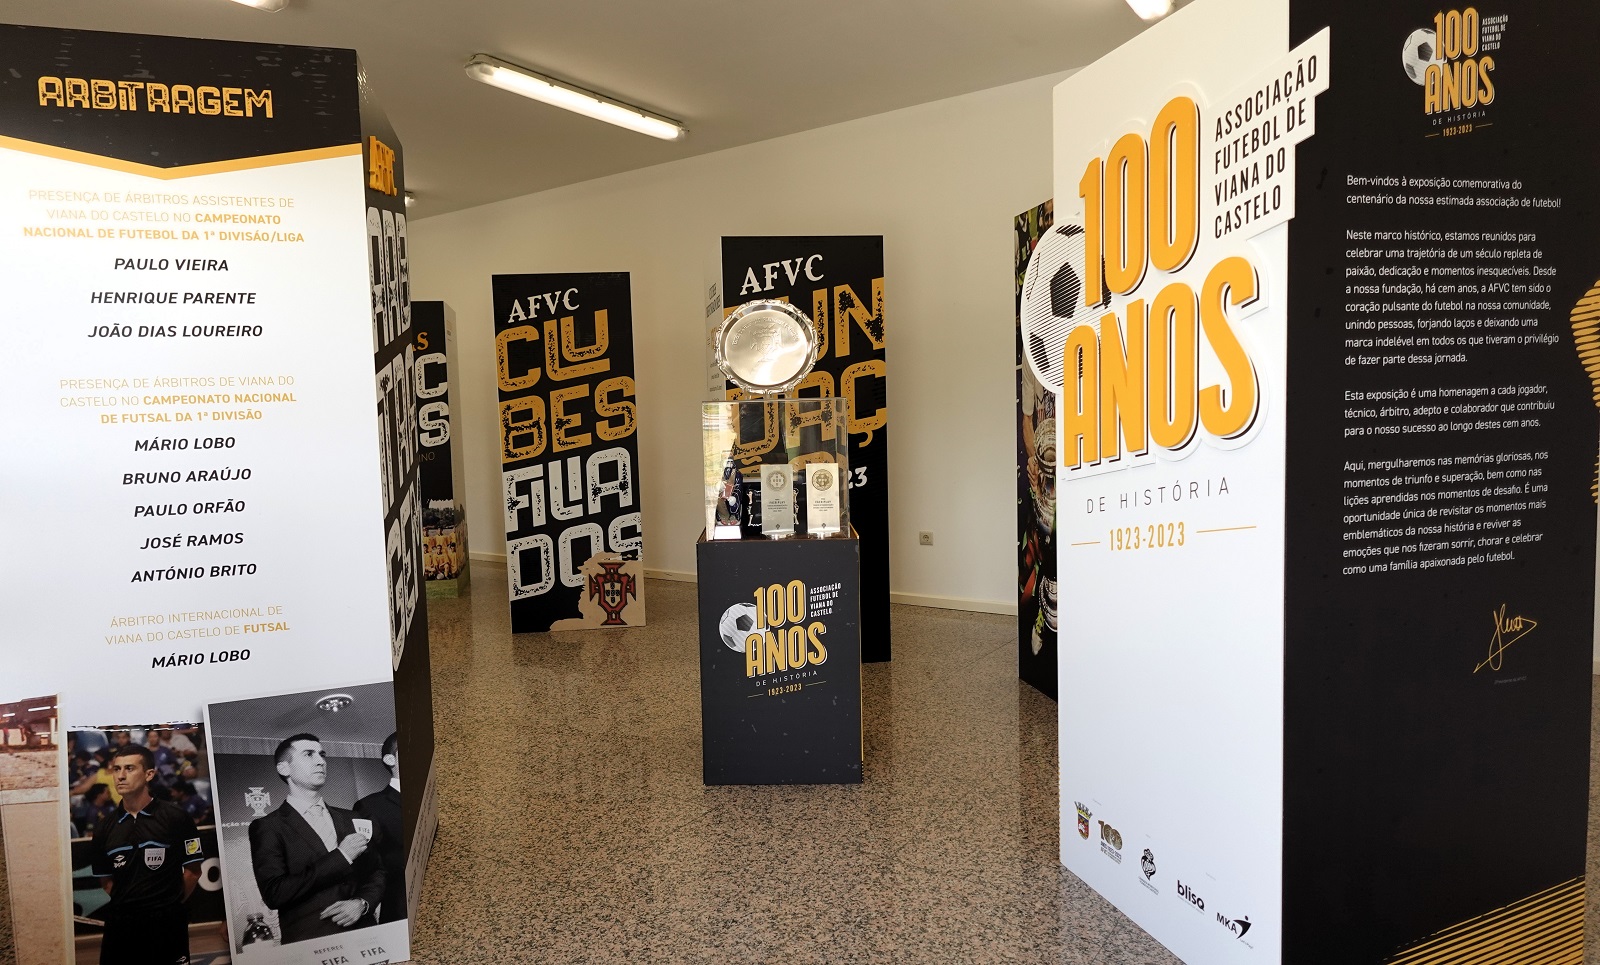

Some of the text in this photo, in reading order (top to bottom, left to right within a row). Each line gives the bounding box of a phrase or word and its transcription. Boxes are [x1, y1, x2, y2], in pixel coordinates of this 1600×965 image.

[1434, 8, 1479, 60] 100
[1482, 26, 1500, 34] FUTEBOL
[1482, 42, 1500, 51] CASTELO
[1425, 56, 1494, 114] ANOS
[38, 76, 274, 118] ARBITRAGEM
[1215, 55, 1317, 142] ASSOCIAÇÃO
[1448, 111, 1486, 122] HISTÓRIA
[1215, 97, 1306, 174] FUTEBOL DE
[1443, 124, 1472, 136] 1923-2023
[1215, 146, 1285, 206] VIANA DO
[1347, 175, 1522, 189] Bem-vindos à exposição comemorativa do
[29, 189, 294, 207] PRESENÇA DE ÁRBITROS ASSISTENTES DE
[1079, 96, 1201, 308] 100
[1347, 194, 1393, 204] centenário
[1396, 194, 1406, 204] da
[1436, 195, 1474, 205] estimada
[1476, 197, 1519, 208] associação
[1521, 197, 1530, 207] de
[1533, 198, 1561, 207] futebol!
[46, 209, 280, 224] VIANA DO CASTELO NO CAMPEONATO
[1215, 184, 1281, 239] CASTELO
[23, 227, 93, 238] NACIONAL
[98, 228, 114, 238] DE
[119, 229, 178, 240] FUTEBOL
[182, 230, 199, 240] DA
[1347, 230, 1536, 243] Neste marco histórico, estamos reunidos para
[115, 258, 228, 271] PAULO VIEIRA
[740, 254, 824, 295] AFVC
[91, 292, 256, 304] HENRIQUE PARENTE
[508, 288, 579, 323] AFVC
[88, 323, 262, 337] JOÃO DIAS LOUREIRO
[1346, 319, 1375, 329] unindo
[1378, 321, 1415, 331] pessoas,
[1418, 318, 1451, 330] forjando
[1454, 318, 1475, 329] laços
[1484, 317, 1519, 327] deixando
[495, 309, 610, 392] CLU
[1064, 256, 1260, 470] ANOS
[60, 376, 294, 390] PRESENÇA DE ÁRBITROS DE VIANA DO
[61, 393, 296, 407] CASTELO NO CAMPEONATO NACIONAL
[1345, 391, 1364, 400] Esta
[1366, 389, 1408, 401] exposição
[1411, 388, 1416, 398] é
[1419, 390, 1436, 398] uma
[1439, 388, 1488, 398] homenagem
[1498, 385, 1516, 395] cada
[1517, 384, 1547, 396] jogador,
[101, 414, 117, 424] DE
[122, 413, 171, 423] FUTSAL
[176, 413, 192, 421] DA
[212, 409, 262, 420] DIVISÃO
[499, 376, 637, 464] BES
[135, 437, 235, 451] MÁRIO LOBO
[123, 467, 251, 485] BRUNO ARAÚJO
[1086, 477, 1229, 514] DE HISTÓRIA
[134, 499, 245, 517] PAULO ORFÃO
[140, 533, 243, 549] JOSÉ RAMOS
[1109, 521, 1185, 551] 1923-2023
[1343, 551, 1515, 574] como uma família apaixonada pelo futebol.
[131, 564, 256, 582] ANTÓNIO BRITO
[810, 582, 841, 595] ASSOCIAÇÃO
[810, 592, 831, 602] FUTEBOL
[754, 580, 805, 629] 100
[811, 608, 832, 617] CASTELO
[111, 606, 282, 627] ÁRBITRO INTERNACIONAL DE
[105, 622, 289, 645] VIANA DO CASTELO DE FUTSAL
[152, 649, 250, 668] MÁRIO LOBO
[745, 622, 827, 678] ANOS
[773, 670, 818, 683] HISTÓRIA
[768, 683, 801, 696] 1923-2023
[1216, 912, 1237, 934] MKA
[360, 946, 386, 958] FIFA
